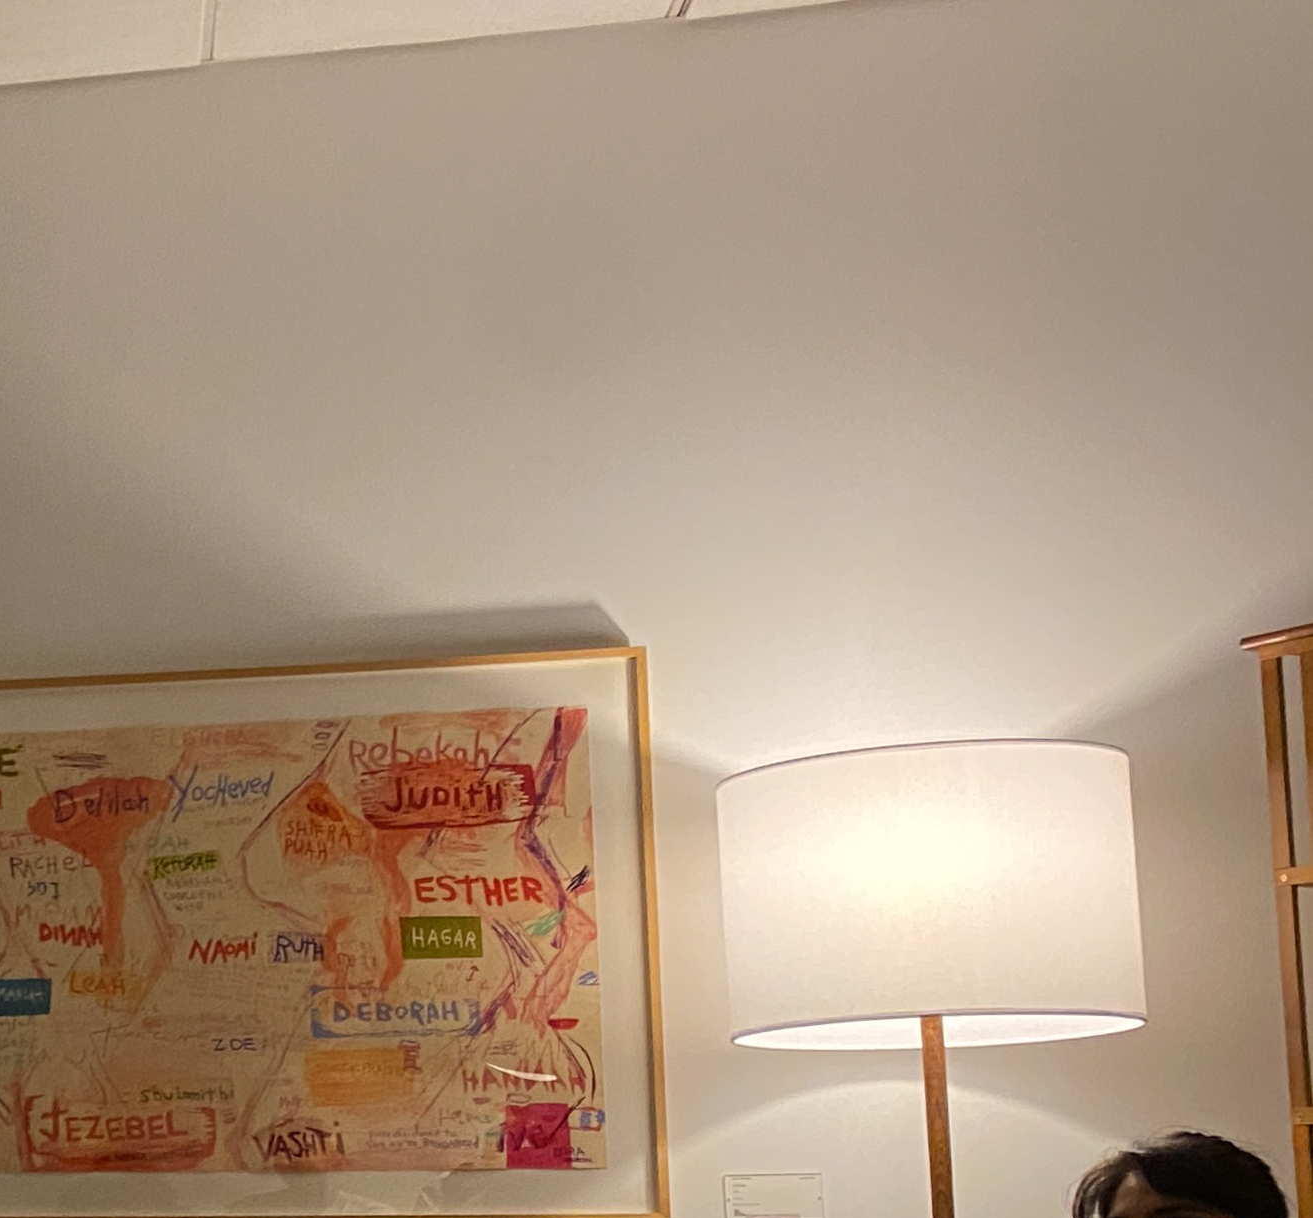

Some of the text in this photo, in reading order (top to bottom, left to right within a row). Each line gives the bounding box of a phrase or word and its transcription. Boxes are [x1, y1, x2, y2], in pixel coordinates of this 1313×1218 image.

[349, 725, 490, 774] Rebekah
[414, 875, 544, 906] ESTHER
[39, 923, 104, 948] DINAH
[273, 935, 324, 963] RUTH
[411, 927, 477, 949] HAGAR
[333, 1000, 460, 1024] DEBORAH
[40, 1099, 188, 1142] JEZEBEL
